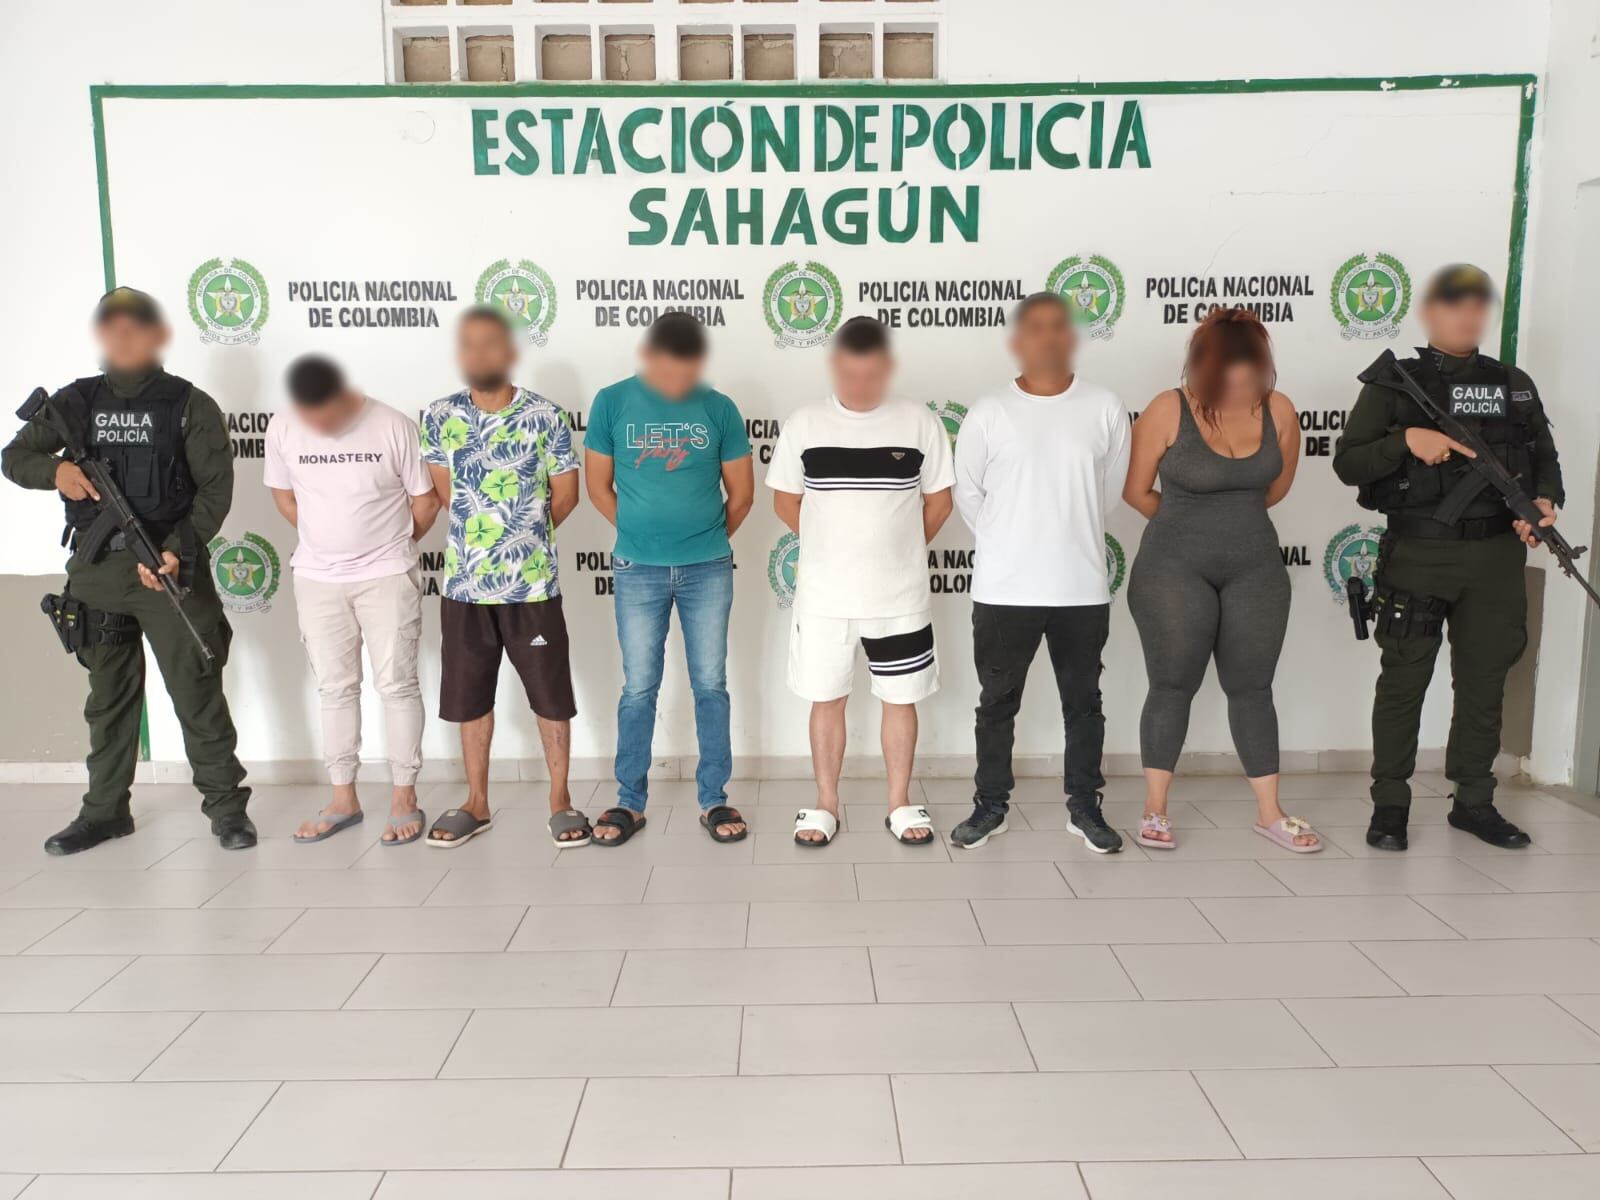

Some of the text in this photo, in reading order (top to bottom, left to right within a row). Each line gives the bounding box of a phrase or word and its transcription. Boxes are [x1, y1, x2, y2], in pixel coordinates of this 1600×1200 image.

[473, 100, 1151, 174] ESTACIÓN DE POLICIA
[629, 182, 980, 244] SAHAGÚN
[288, 281, 457, 302] POLICIA NACIONAL
[576, 279, 744, 300] POLICIA NACIONAL
[859, 280, 1026, 303] POLICIA NACIONAL
[1146, 275, 1314, 298] POLICIA NACIONAL
[309, 307, 439, 328] DE COLOMBIA
[596, 306, 620, 327] DE
[877, 306, 1006, 328] DE COLOMBIA
[1164, 303, 1188, 324] DE
[1452, 387, 1504, 400] GAULA
[95, 413, 153, 427] GAULA
[746, 419, 780, 439] ICIA
[1296, 410, 1346, 431] OLICI
[1306, 436, 1330, 456] DE
[298, 453, 383, 464] MONASTERY
[576, 551, 614, 571] POLI
